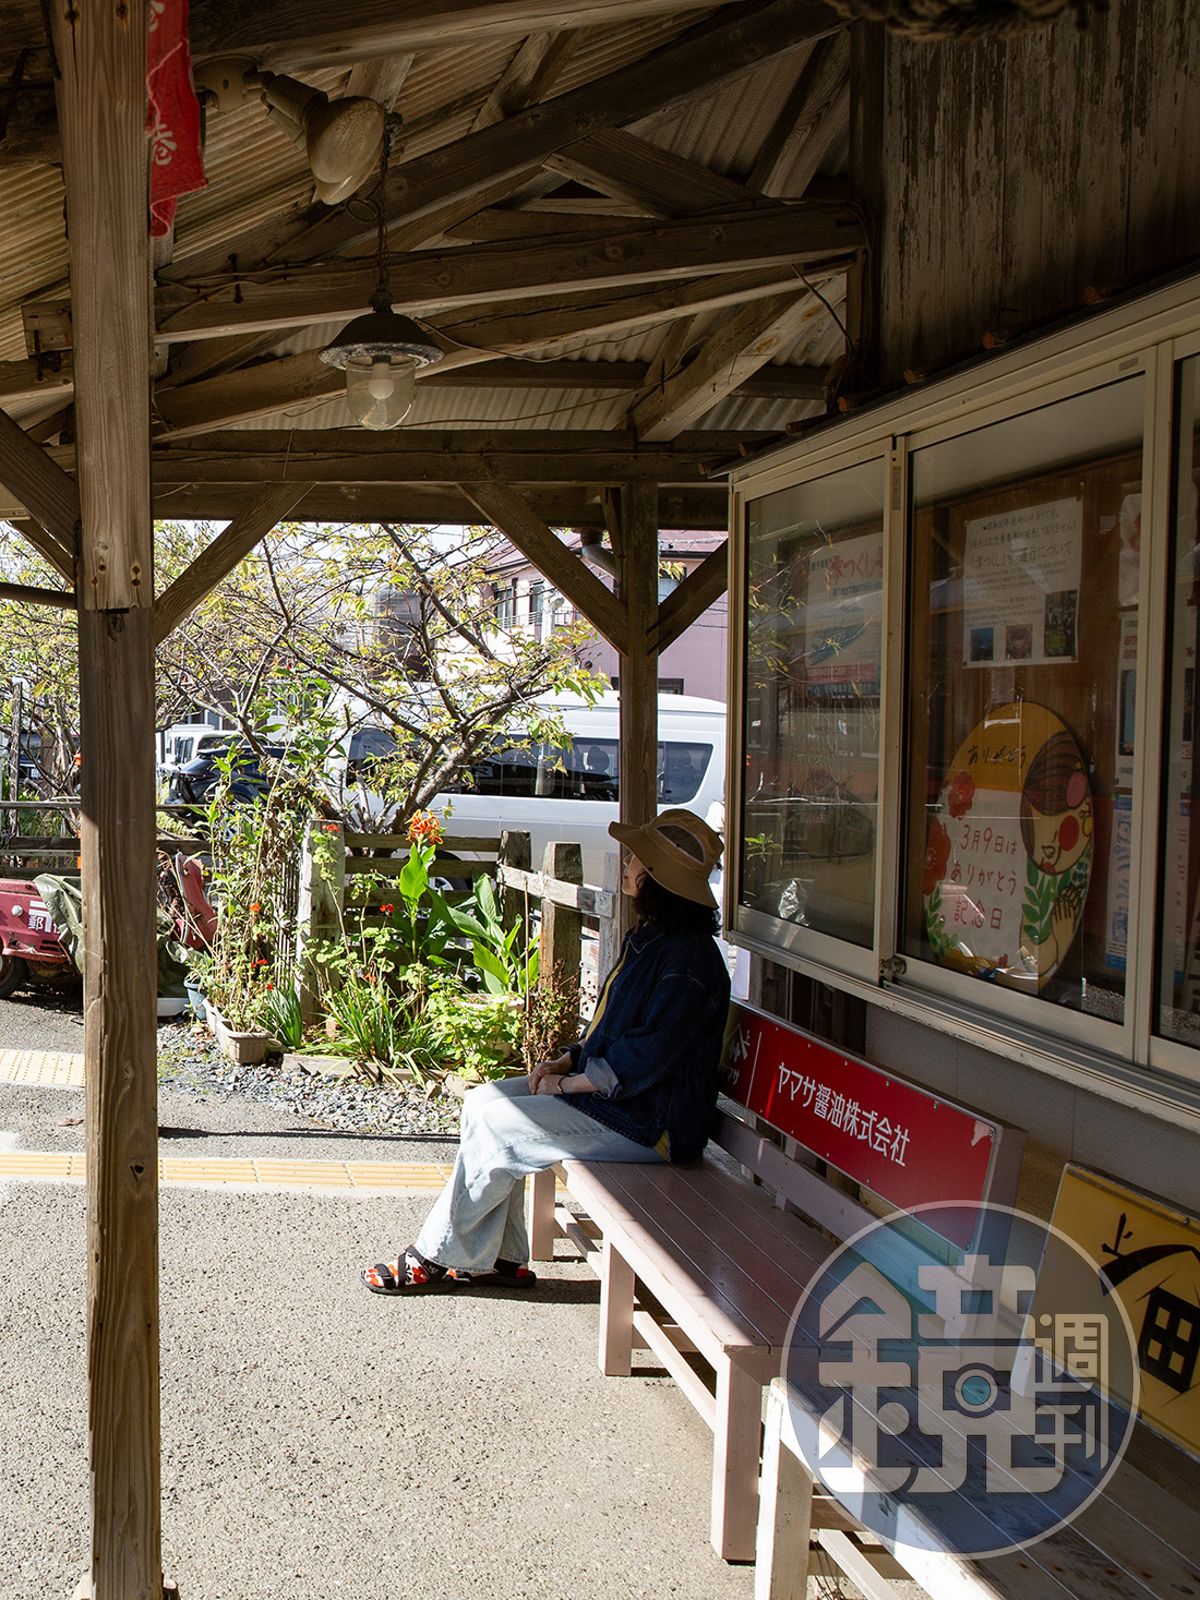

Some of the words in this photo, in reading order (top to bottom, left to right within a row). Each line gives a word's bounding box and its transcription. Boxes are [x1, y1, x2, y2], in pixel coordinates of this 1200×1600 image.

[968, 743, 1026, 769] ありがとう
[960, 824, 1017, 855] 3月9日は
[951, 861, 1016, 895] ありがとう
[954, 899, 1002, 930] 記念日
[778, 1061, 910, 1168] ヤマサ醤油株式会社
